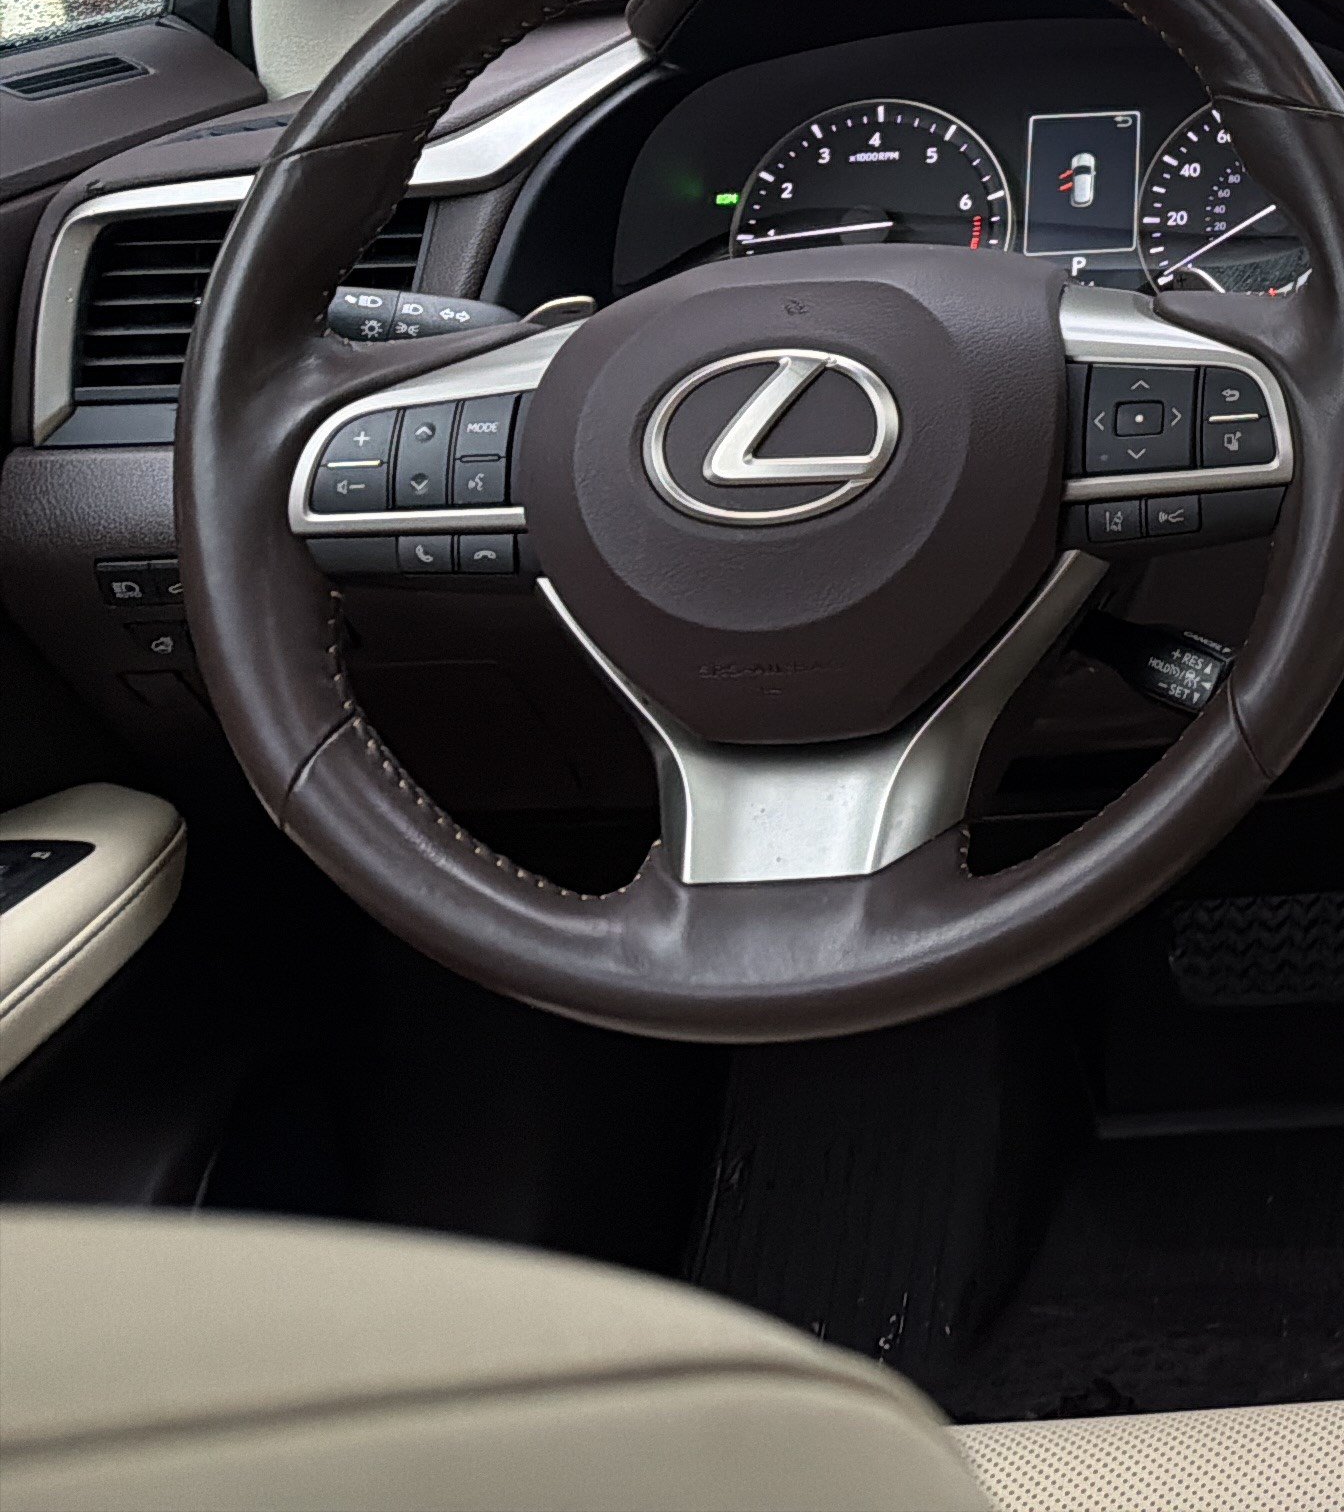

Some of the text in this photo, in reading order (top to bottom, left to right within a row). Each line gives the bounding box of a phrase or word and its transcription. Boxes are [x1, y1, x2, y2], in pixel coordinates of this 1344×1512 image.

[868, 132, 882, 148] 4
[818, 147, 831, 164] 3
[925, 147, 939, 164] 5
[1179, 162, 1201, 178] 40
[1227, 173, 1241, 184] 80
[780, 182, 793, 199] 2
[1217, 188, 1231, 199] 60
[958, 194, 973, 210] 6
[1213, 204, 1226, 214] 40
[1166, 210, 1188, 226] 20
[1213, 221, 1227, 232] 20
[1071, 256, 1087, 277] P
[466, 422, 499, 433] MODE
[1181, 652, 1205, 670] RES
[1168, 683, 1191, 700] SET
